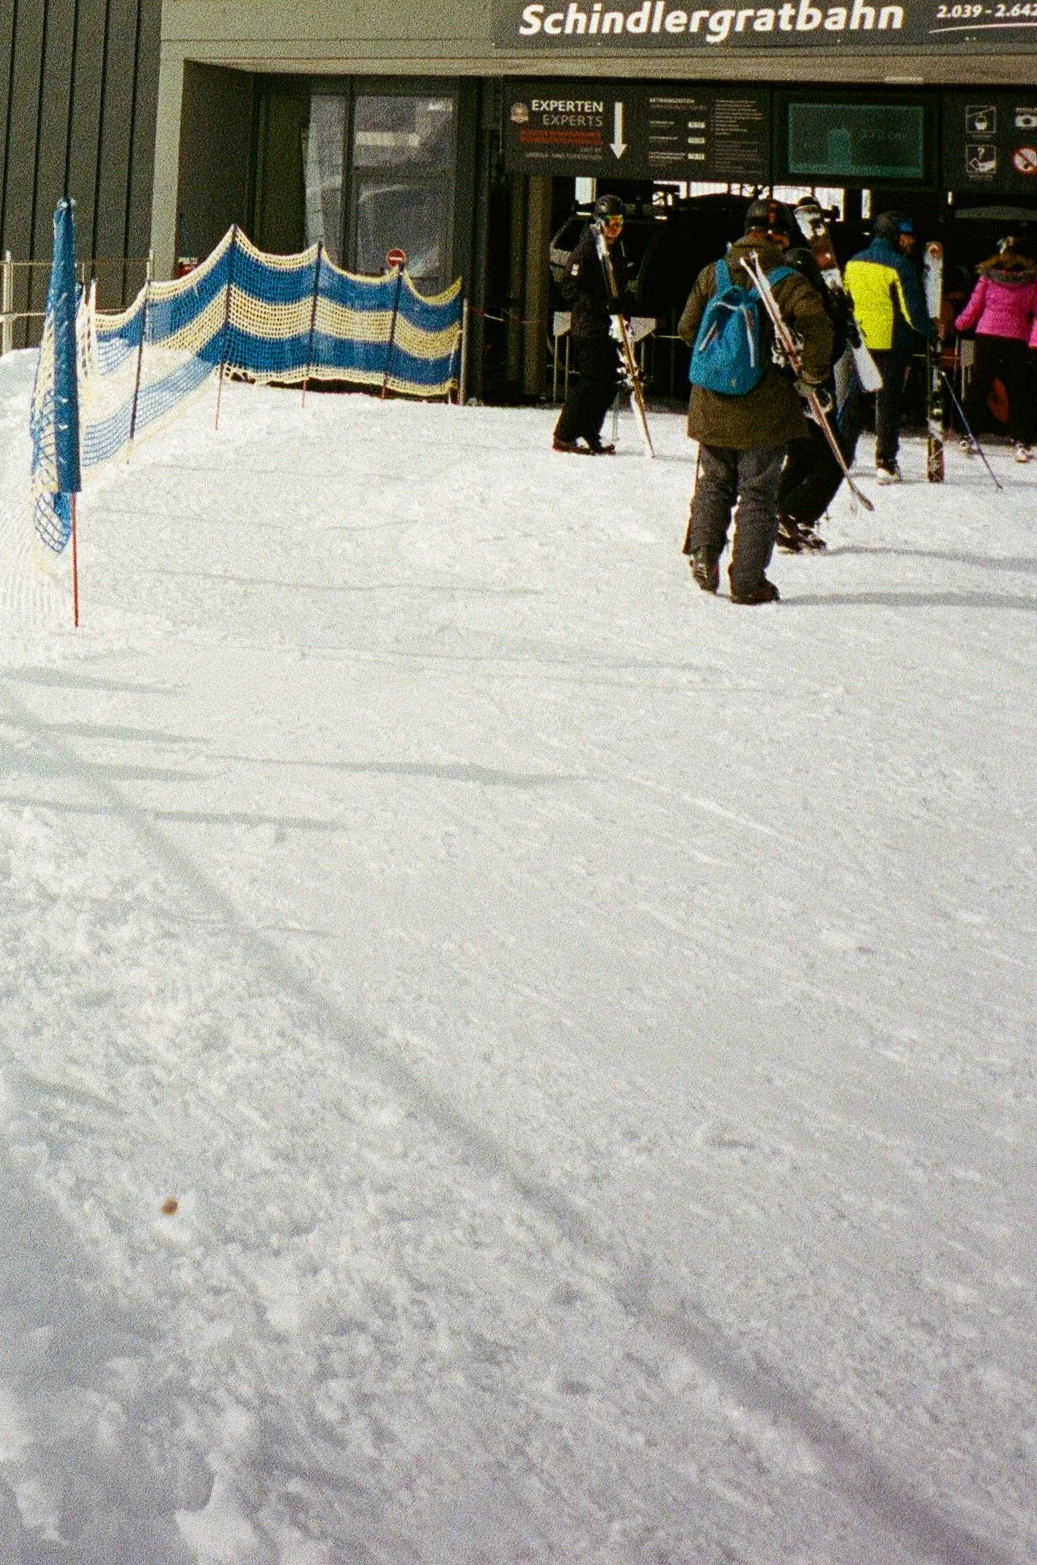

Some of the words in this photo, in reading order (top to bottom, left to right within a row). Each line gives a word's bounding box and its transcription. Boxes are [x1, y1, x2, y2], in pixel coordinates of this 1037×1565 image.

[936, 4, 982, 18] 2.039
[531, 99, 604, 113] EXPERTEN
[542, 115, 603, 127] EXPERTS
